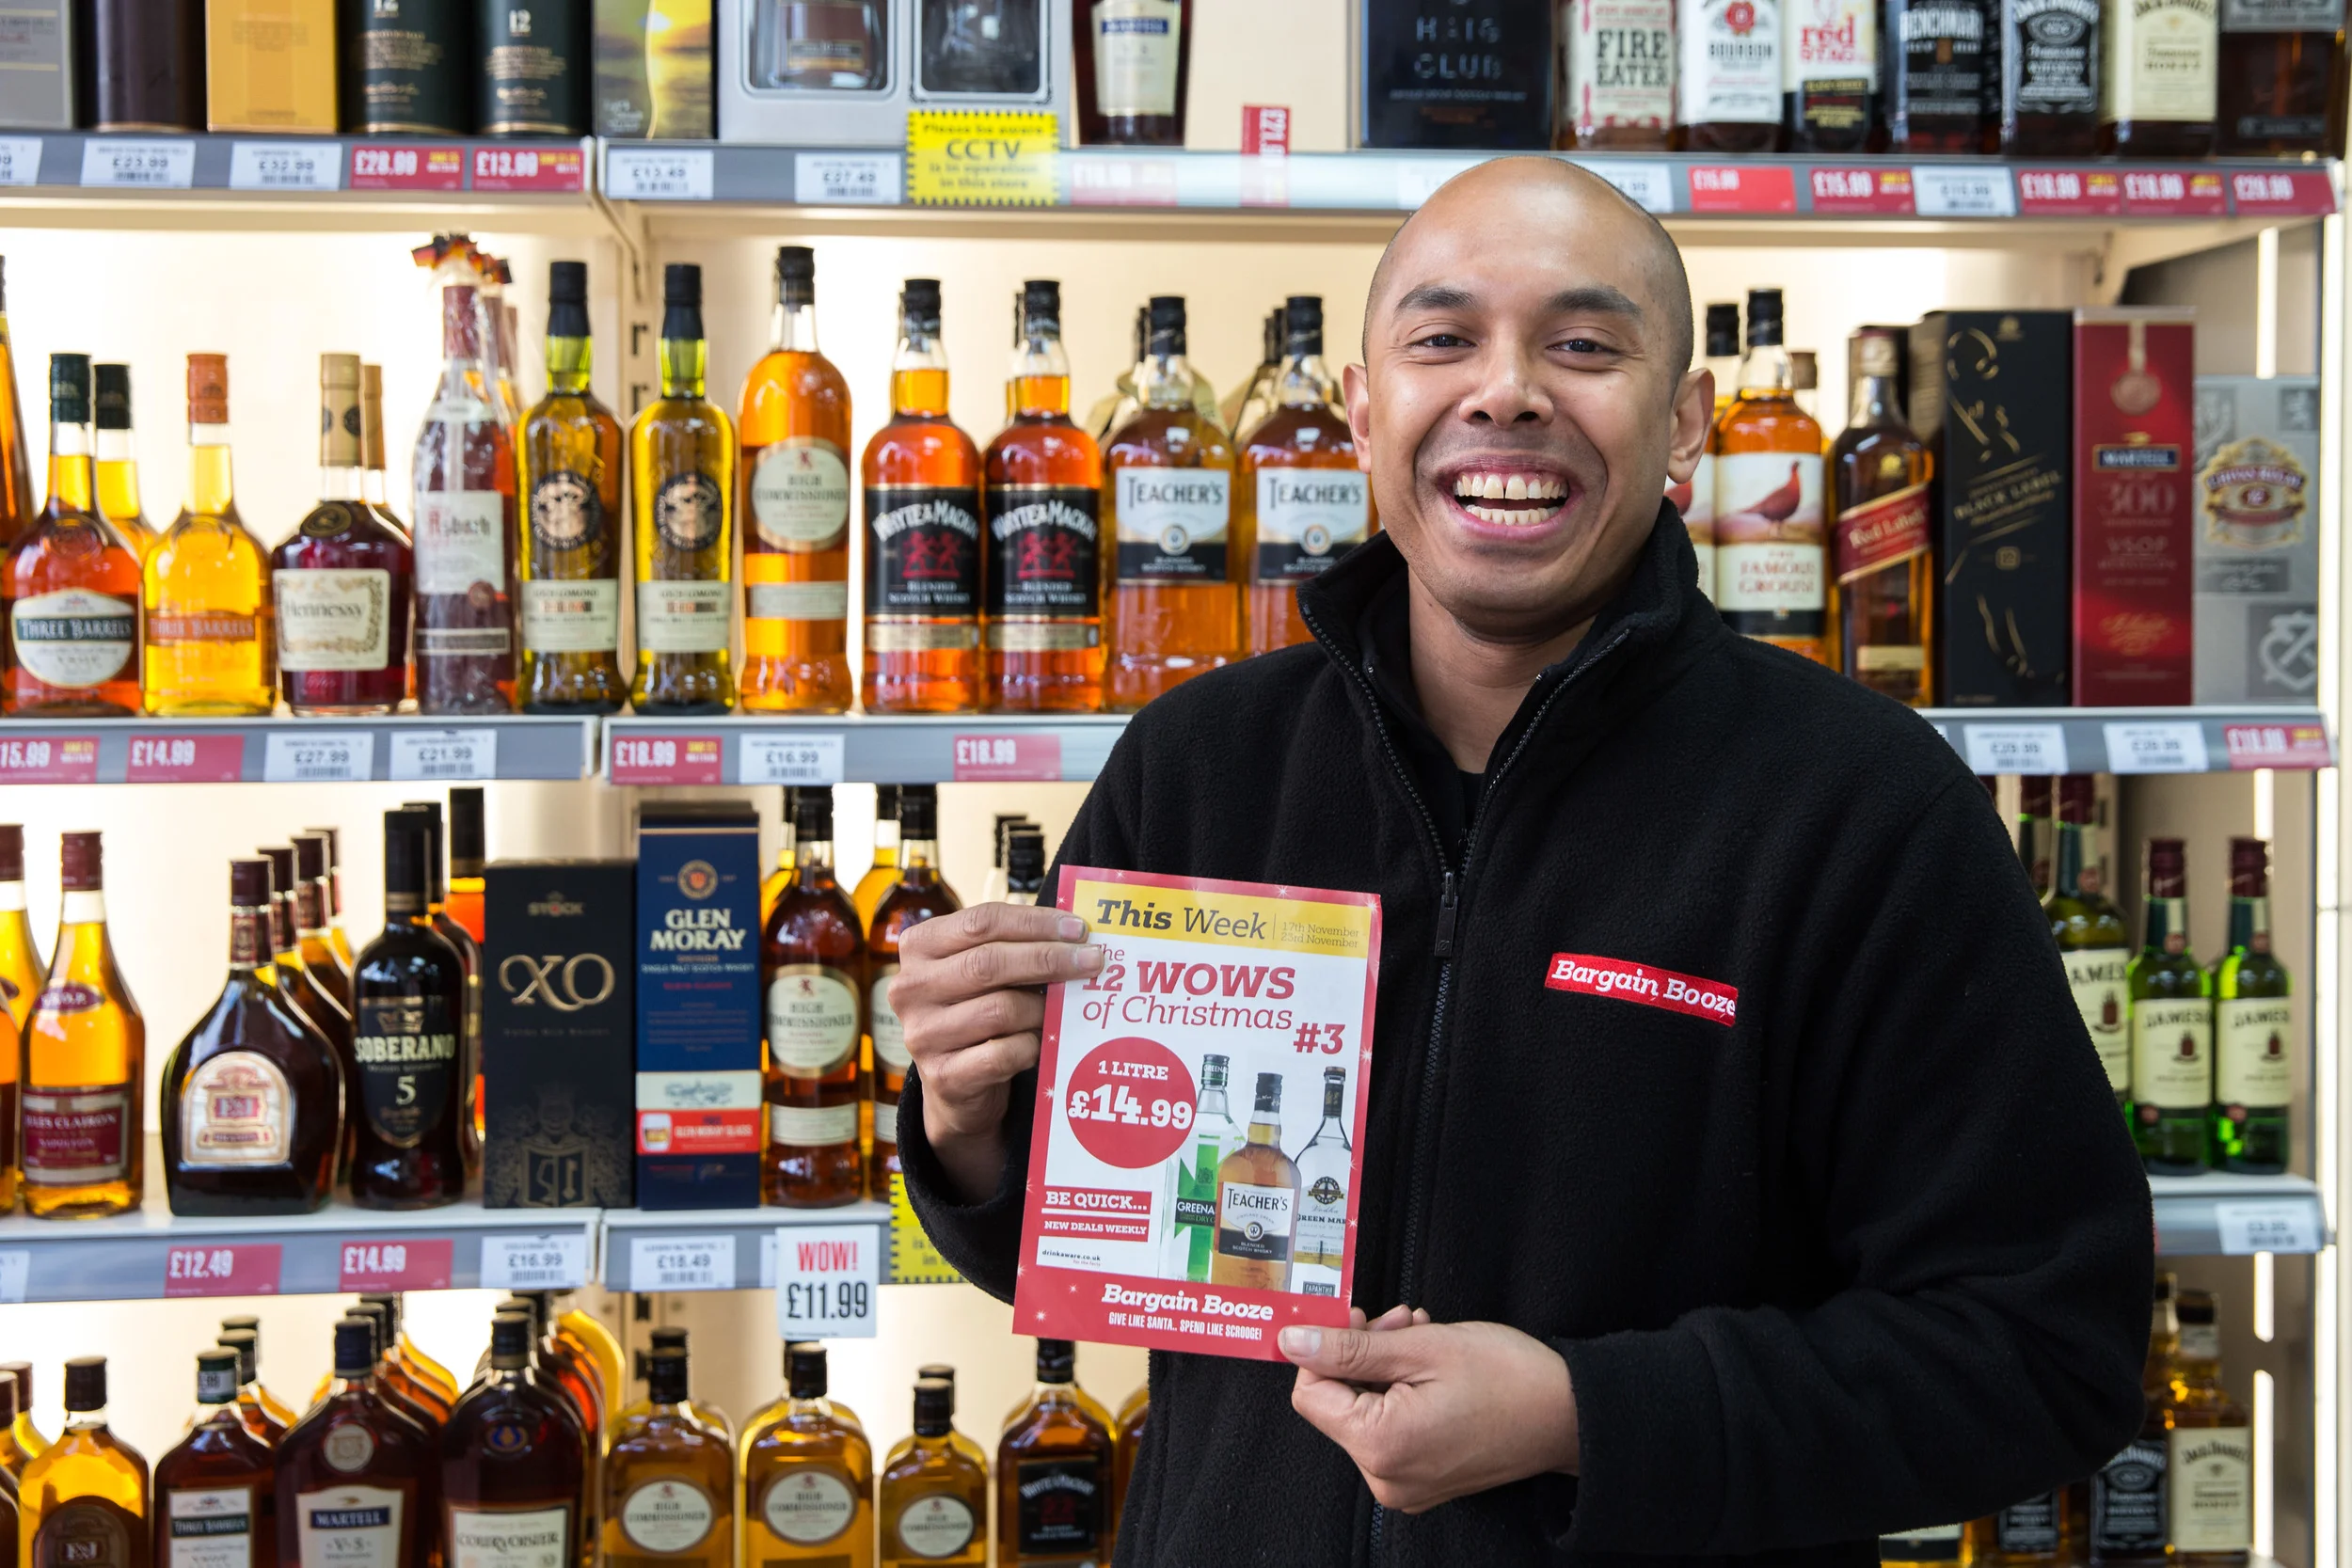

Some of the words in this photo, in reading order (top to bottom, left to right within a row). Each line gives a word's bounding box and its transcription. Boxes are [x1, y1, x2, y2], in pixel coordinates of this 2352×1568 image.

[1597, 29, 1669, 58] FIRE
[1801, 13, 1854, 45] red
[1597, 63, 1669, 87] EATER
[946, 139, 1020, 160] CCTV
[1126, 476, 1224, 509] TEACHER'S
[1268, 477, 1363, 509] TEACHER'S
[23, 620, 67, 639] THREE
[70, 618, 132, 639] BARRELS
[150, 619, 185, 638] THREE
[193, 618, 254, 639] BARRELS
[132, 739, 196, 767] £14.99
[665, 908, 731, 930] GLEN
[1096, 898, 1173, 930] This
[1184, 906, 1269, 940] Week
[1282, 921, 1305, 933] 17th
[1308, 924, 1359, 937] November
[650, 928, 747, 951] MORAY
[1281, 932, 1304, 943] 23rd
[1306, 934, 1359, 947] November
[498, 953, 616, 1012] XO
[1083, 963, 1126, 992] 12
[1136, 960, 1296, 999] WOWS
[1551, 959, 1659, 996] Bargain
[1663, 978, 1736, 1016] Booze
[1083, 993, 1117, 1029] of
[1122, 994, 1293, 1030] Christmas
[354, 1034, 456, 1064] SOBERANO
[1294, 1022, 1346, 1054] #3
[1098, 1060, 1108, 1074] 1
[1111, 1061, 1169, 1081] LITRE
[395, 1075, 417, 1106] 5
[1068, 1084, 1193, 1130] £14.99
[1046, 1191, 1071, 1205] BE
[1073, 1193, 1147, 1211] QUICK...
[1228, 1188, 1288, 1212] TEACHER'S
[1044, 1221, 1070, 1230] NEW
[1071, 1222, 1104, 1232] DEALS
[1105, 1224, 1147, 1234] WEEKLY
[170, 1250, 234, 1277] £12.49
[798, 1241, 858, 1272] WOW!
[1042, 1249, 1101, 1261] drinkaware.co.uk
[787, 1281, 868, 1320] £11.99
[1102, 1283, 1198, 1313] Bargain
[1201, 1294, 1275, 1321] Booze
[1108, 1311, 1127, 1325] GIVE
[1128, 1314, 1145, 1327] LIKE
[1147, 1315, 1177, 1331] SANTA..
[1180, 1320, 1205, 1334] SPEND
[1207, 1322, 1224, 1337] LIKE
[1225, 1323, 1263, 1340] SCROOGE!
[315, 1511, 382, 1528] MARTELL
